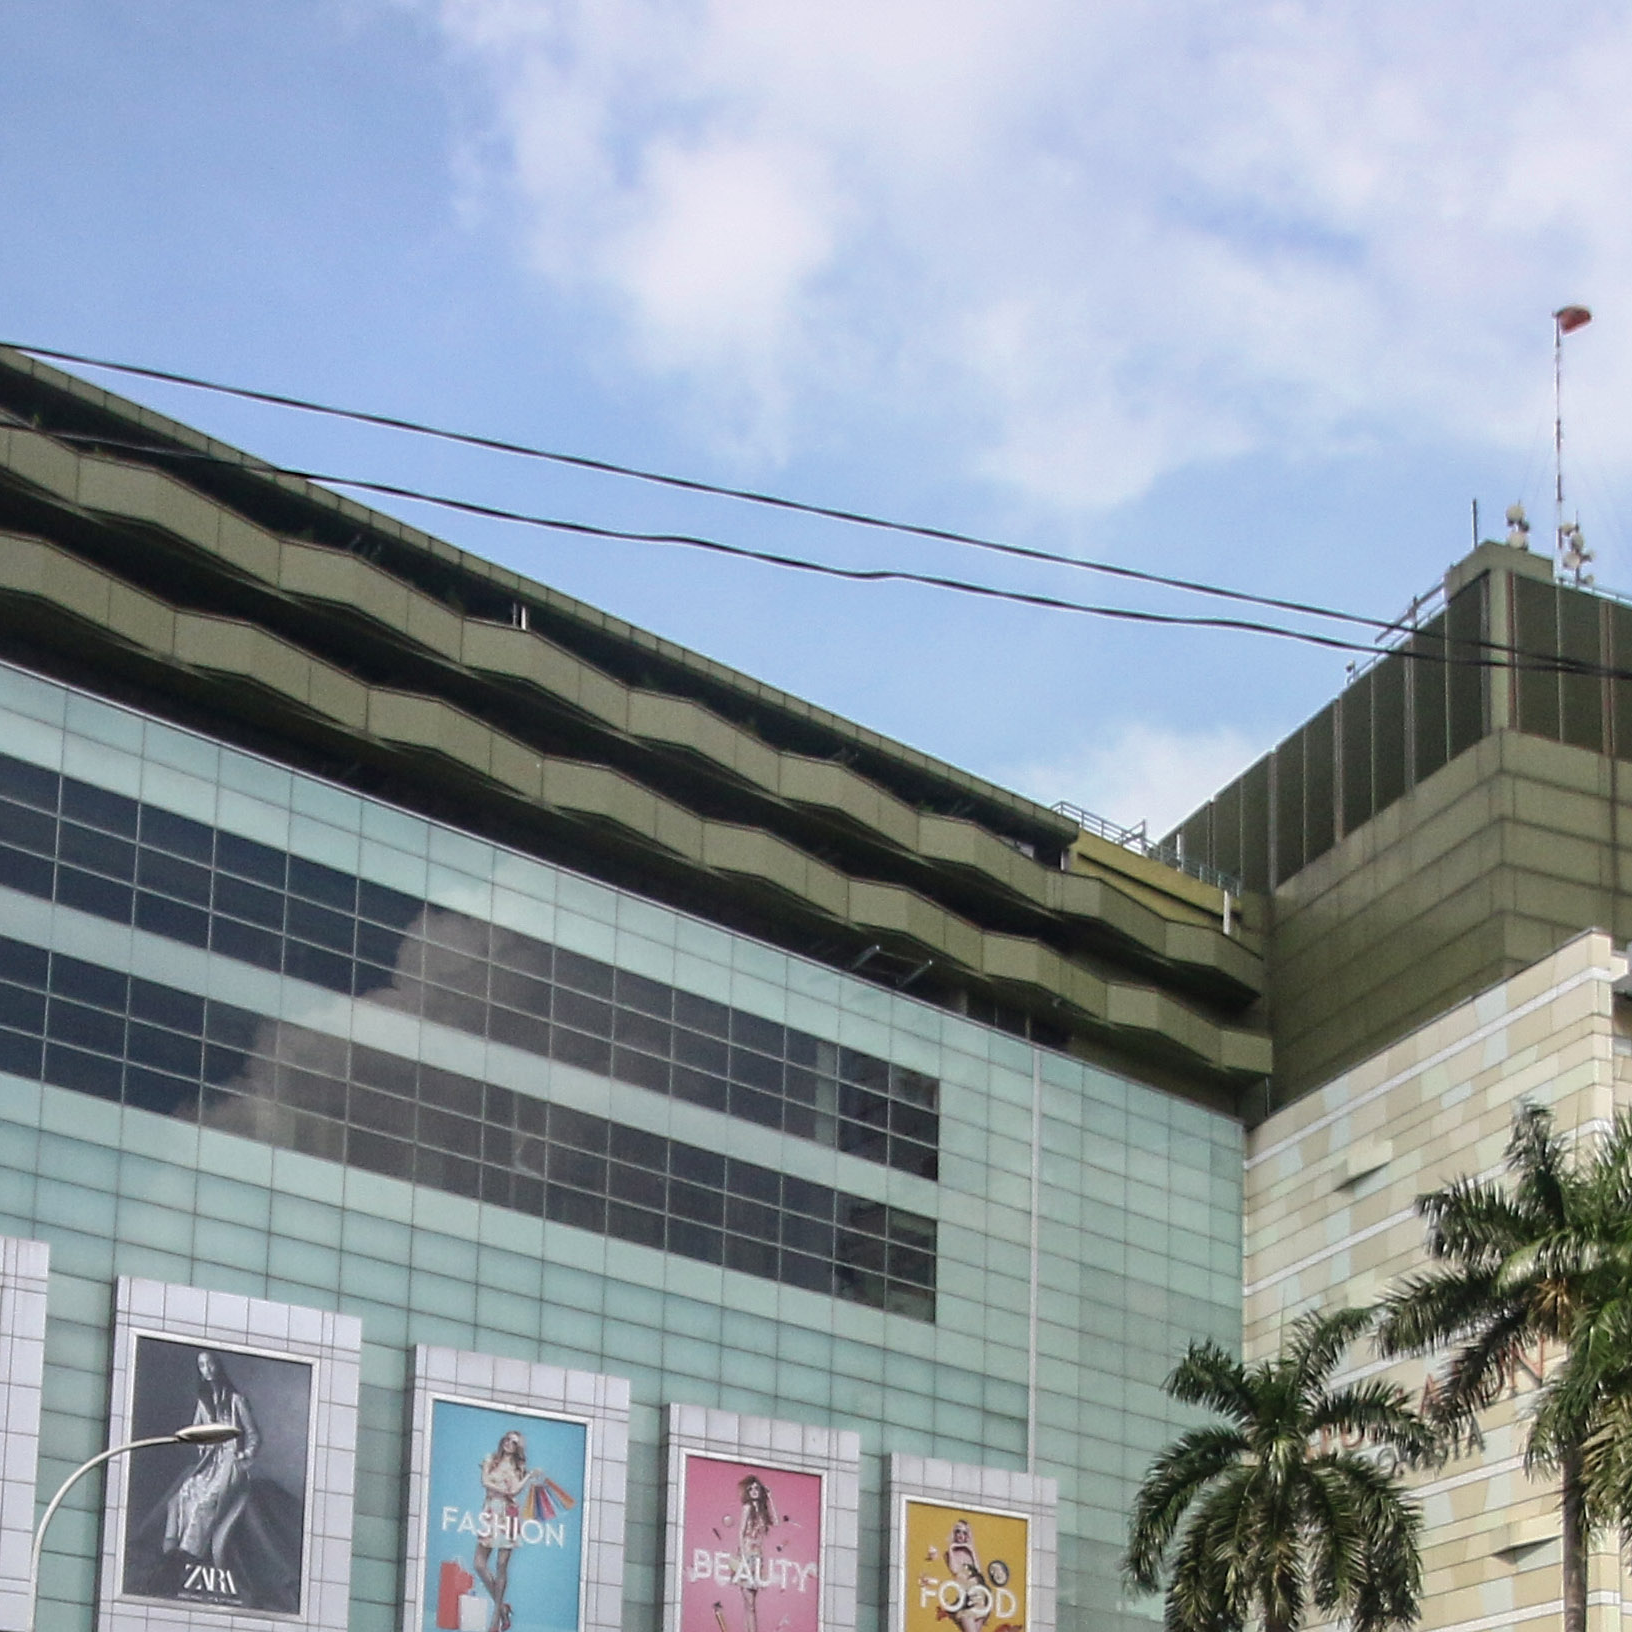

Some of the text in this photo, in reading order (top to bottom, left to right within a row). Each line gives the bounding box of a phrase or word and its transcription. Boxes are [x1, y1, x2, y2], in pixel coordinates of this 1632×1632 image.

[441, 1505, 566, 1549] FASHION
[691, 1548, 818, 1594] BEAUTY
[918, 1577, 1017, 1619] FOOD
